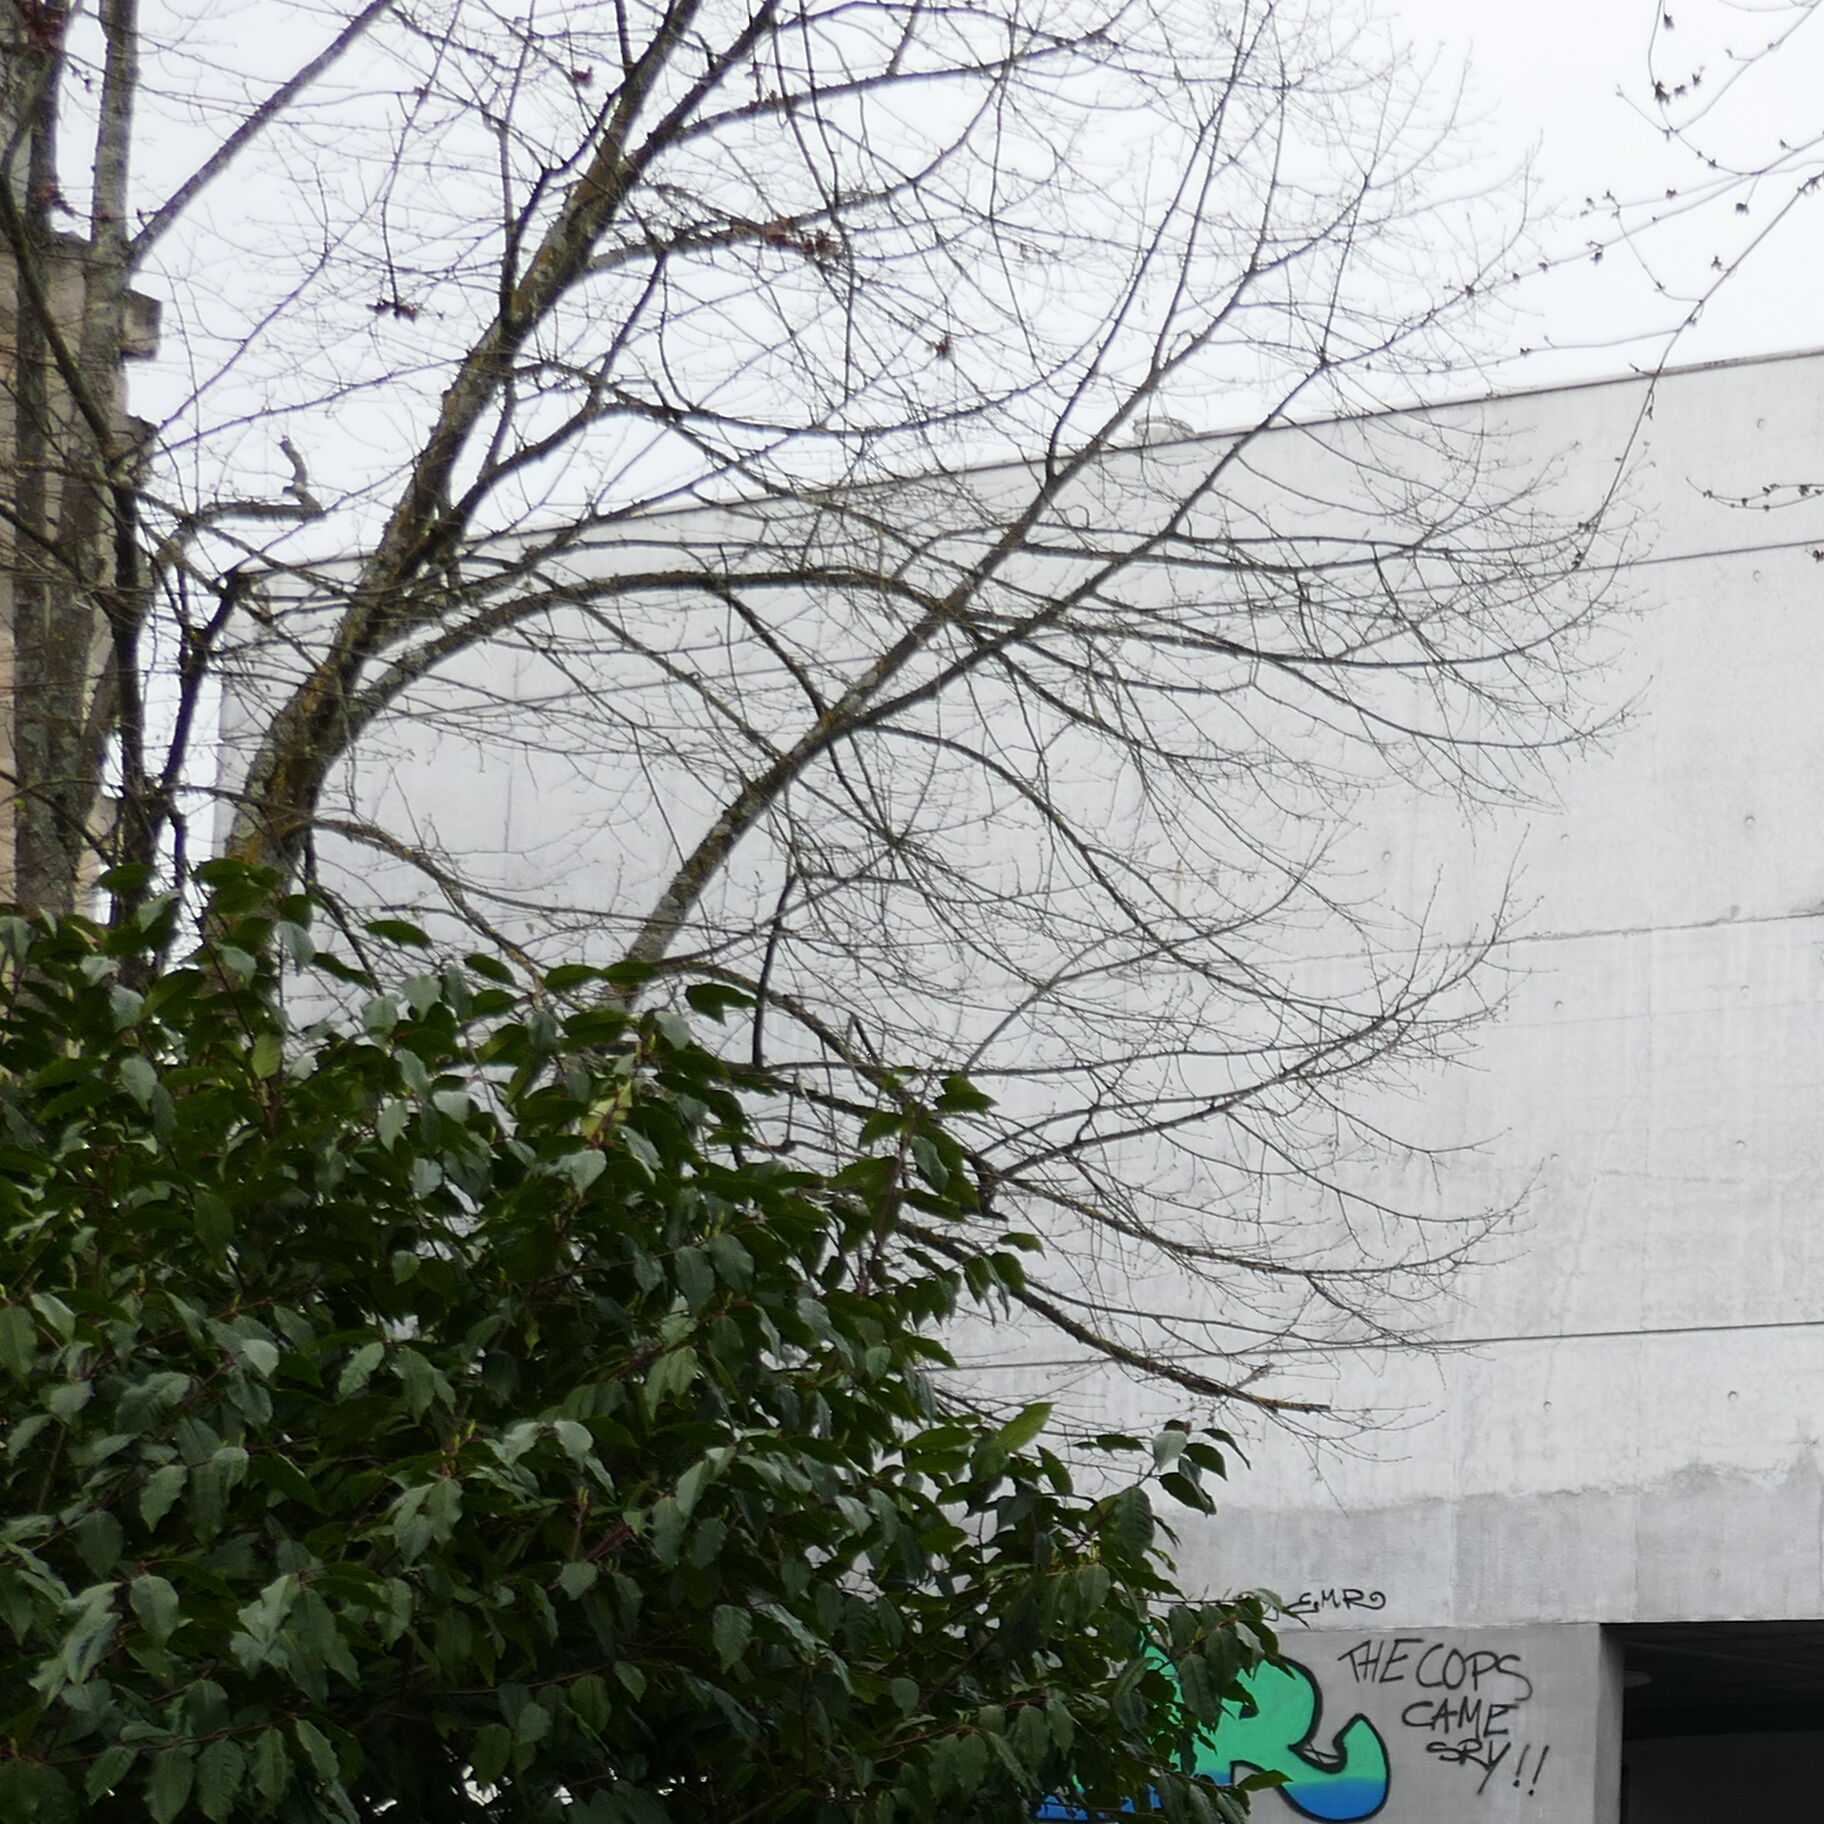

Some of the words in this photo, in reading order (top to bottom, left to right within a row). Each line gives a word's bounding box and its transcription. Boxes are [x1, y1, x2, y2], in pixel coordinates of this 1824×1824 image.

[1338, 1637, 1424, 1684] THE
[1416, 1642, 1533, 1702] COPS
[1401, 1696, 1520, 1744] CAME
